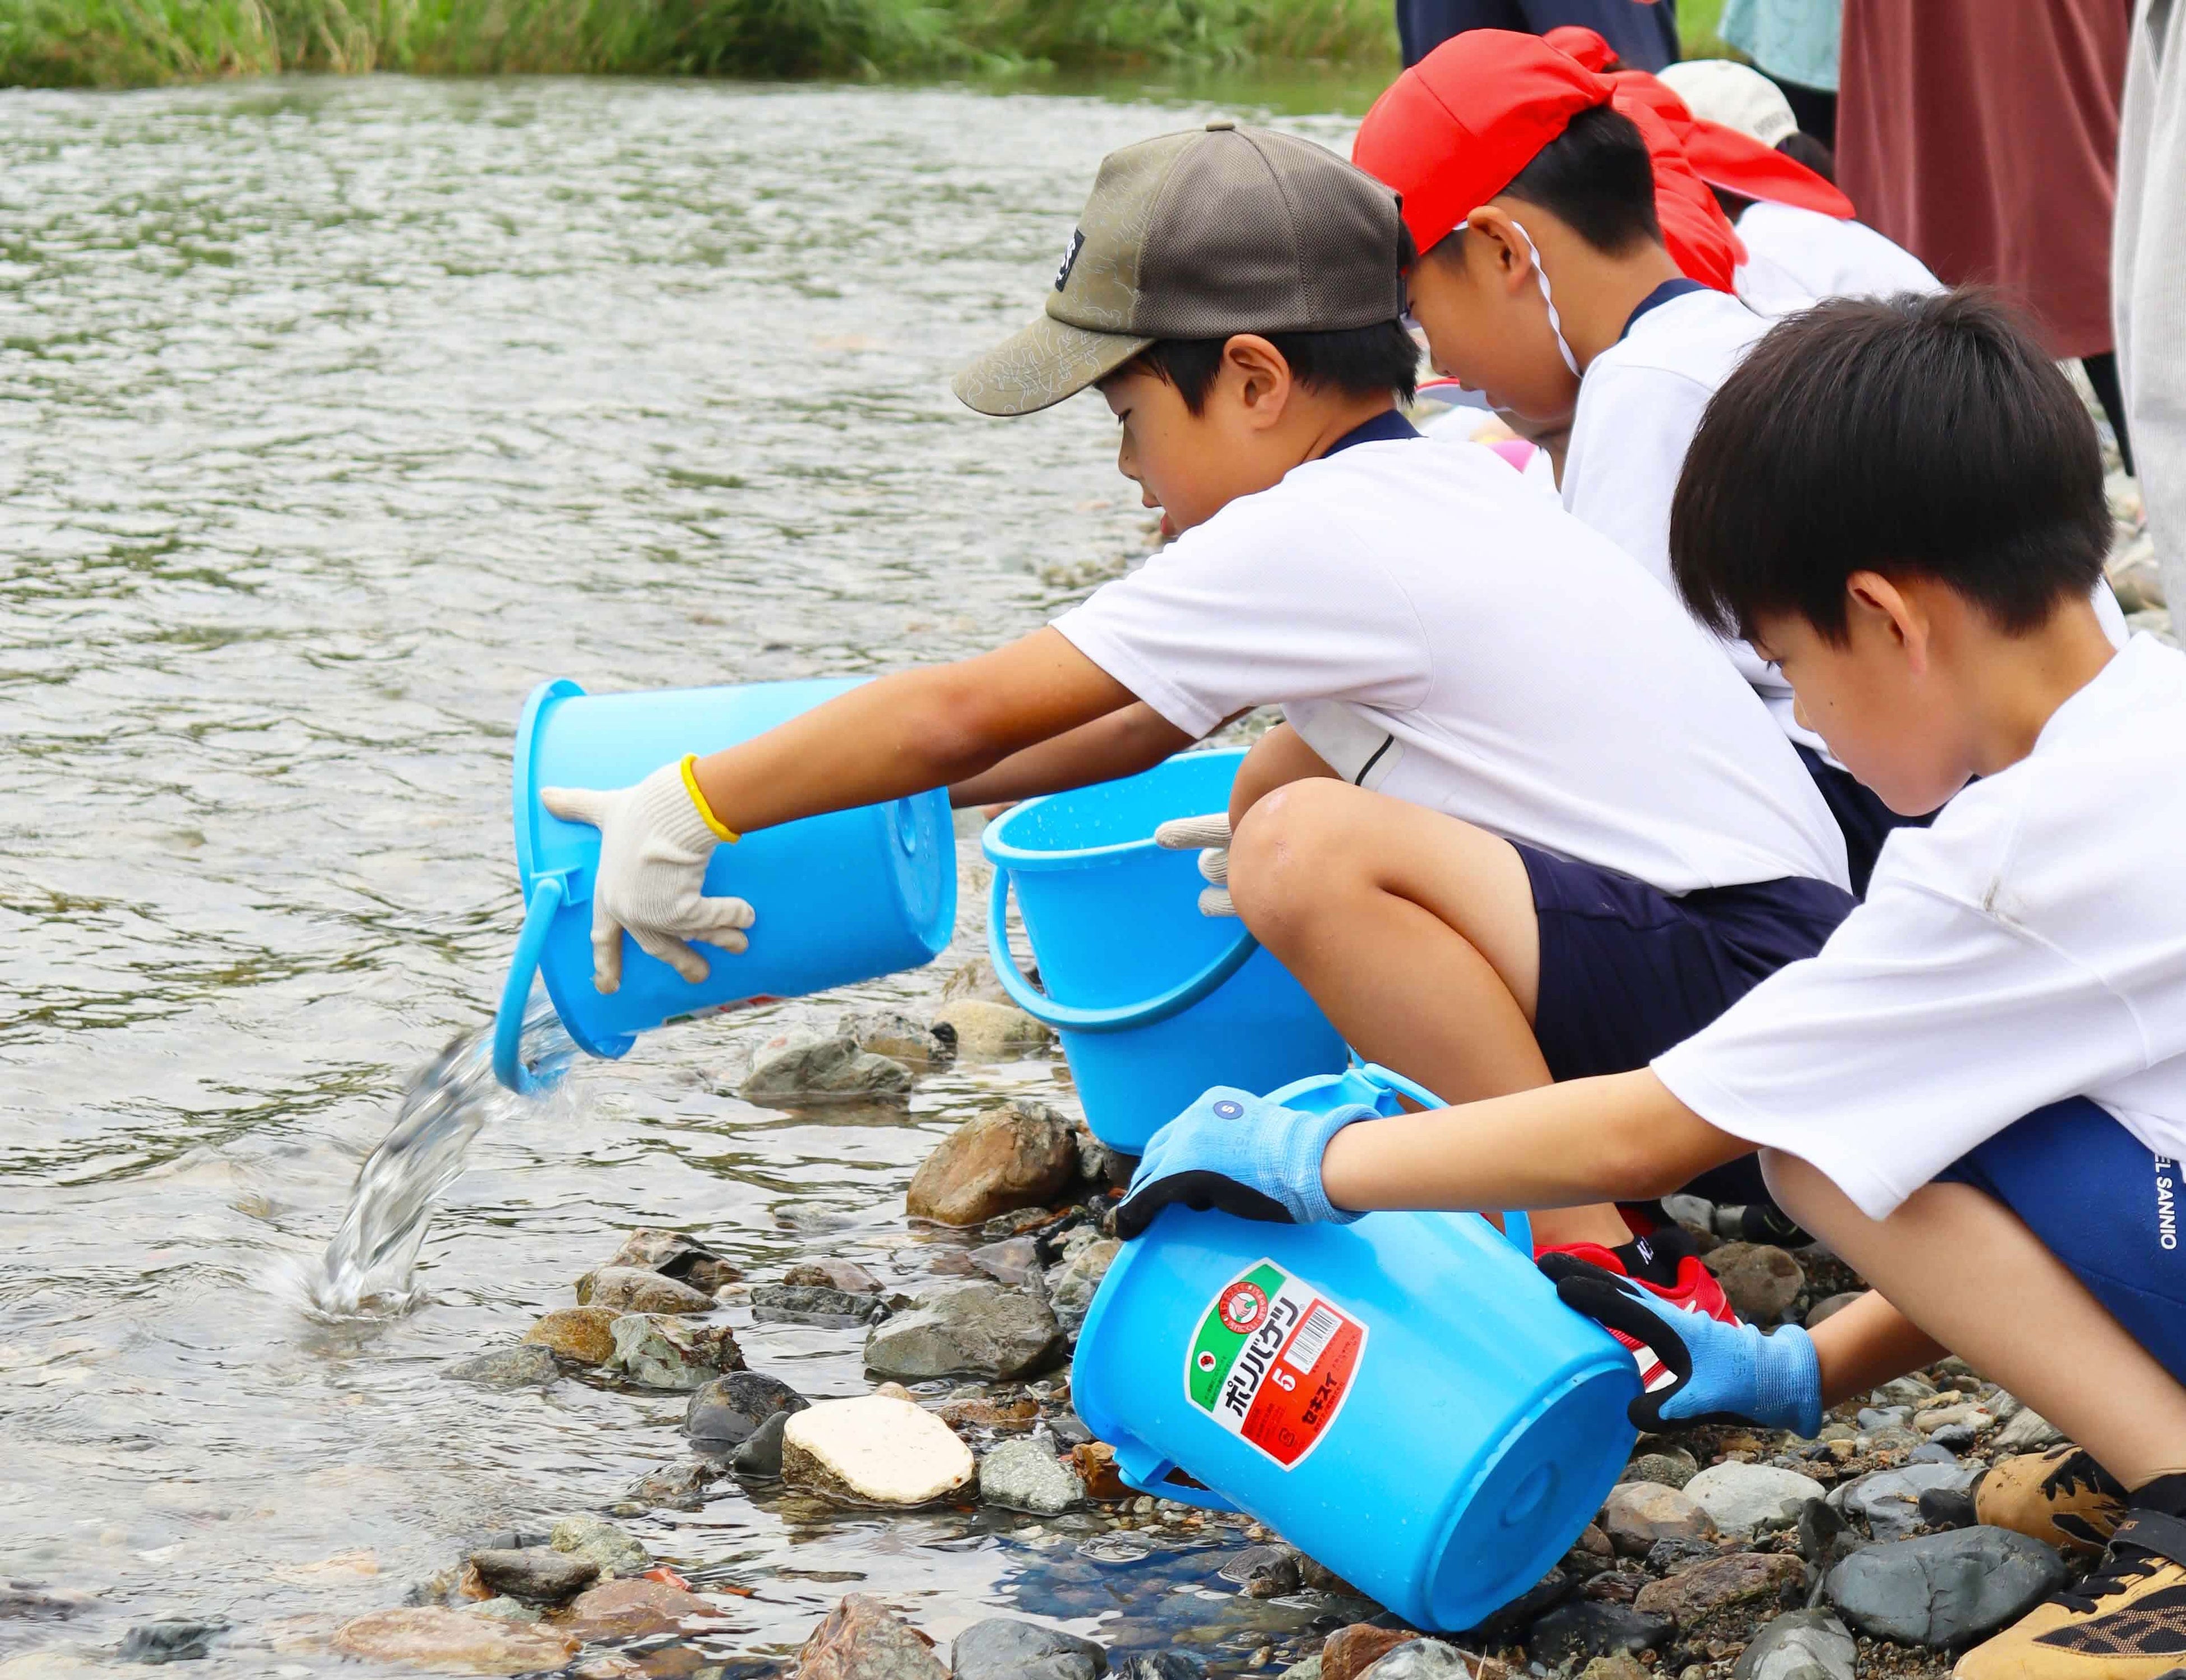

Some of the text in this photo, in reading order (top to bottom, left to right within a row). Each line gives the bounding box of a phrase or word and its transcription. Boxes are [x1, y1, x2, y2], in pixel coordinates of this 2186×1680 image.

[2156, 1177, 2177, 1250] SANNIO
[1225, 1297, 1299, 1418] ポリバケツ
[1272, 1368, 1296, 1392] 5
[1302, 1372, 1337, 1424] セキスイ
